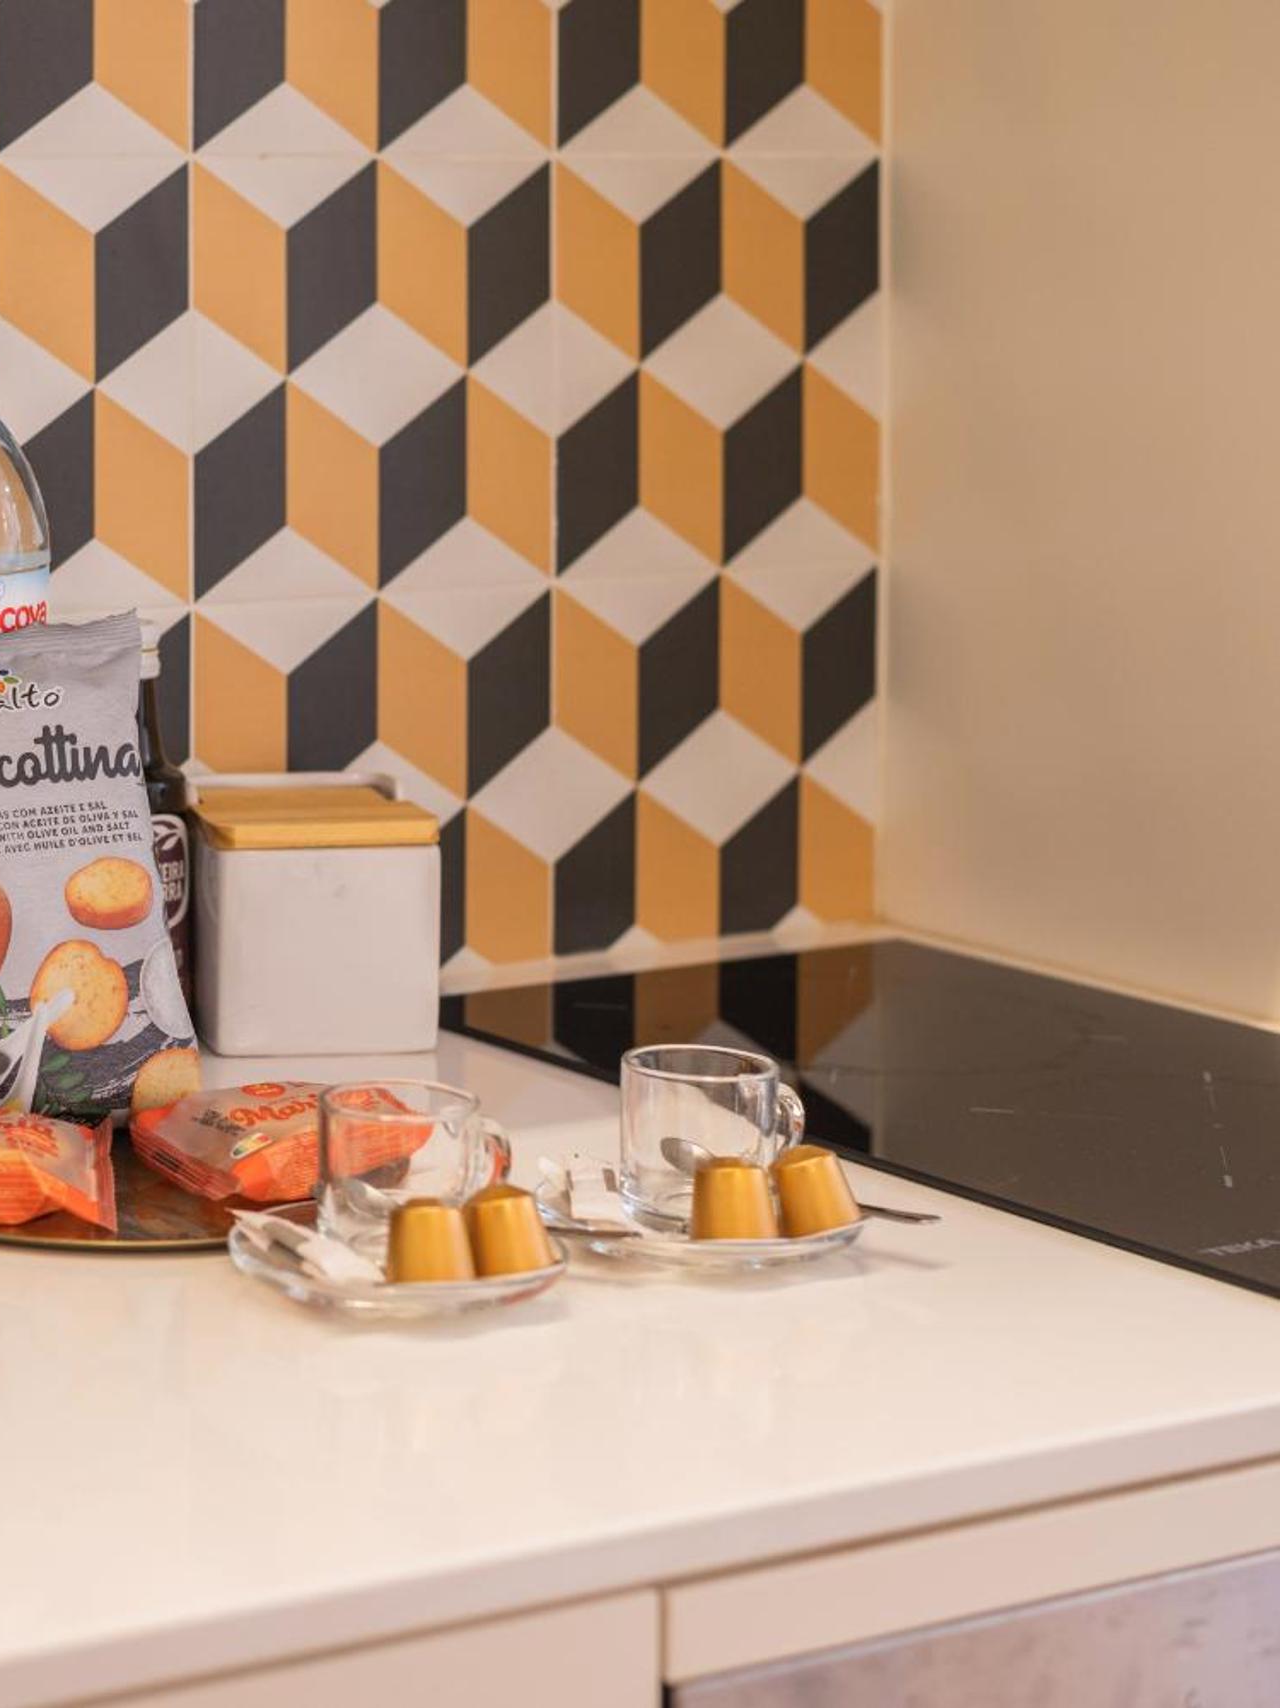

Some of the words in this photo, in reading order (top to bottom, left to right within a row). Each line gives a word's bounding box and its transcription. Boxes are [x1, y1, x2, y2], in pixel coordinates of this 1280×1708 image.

[12, 807, 37, 819] COM
[40, 803, 77, 816] AZEITE
[79, 802, 85, 811] E
[87, 800, 108, 810] SAL
[22, 816, 60, 829] ACEITE
[62, 814, 76, 825] DE
[78, 811, 111, 823] OLIVA
[112, 811, 119, 820] Y
[121, 808, 139, 819] SAL
[26, 828, 59, 841] OLIVE
[61, 826, 79, 836] OIL
[82, 822, 104, 834] AND
[106, 820, 131, 832] SALT
[4, 842, 31, 855] AVEC
[33, 839, 66, 852] HUILE
[68, 835, 110, 848] D'OLIVE
[112, 833, 124, 843] ET
[126, 831, 144, 842] SEL
[159, 859, 184, 881] EIRA
[229, 1093, 318, 1126] Mari
